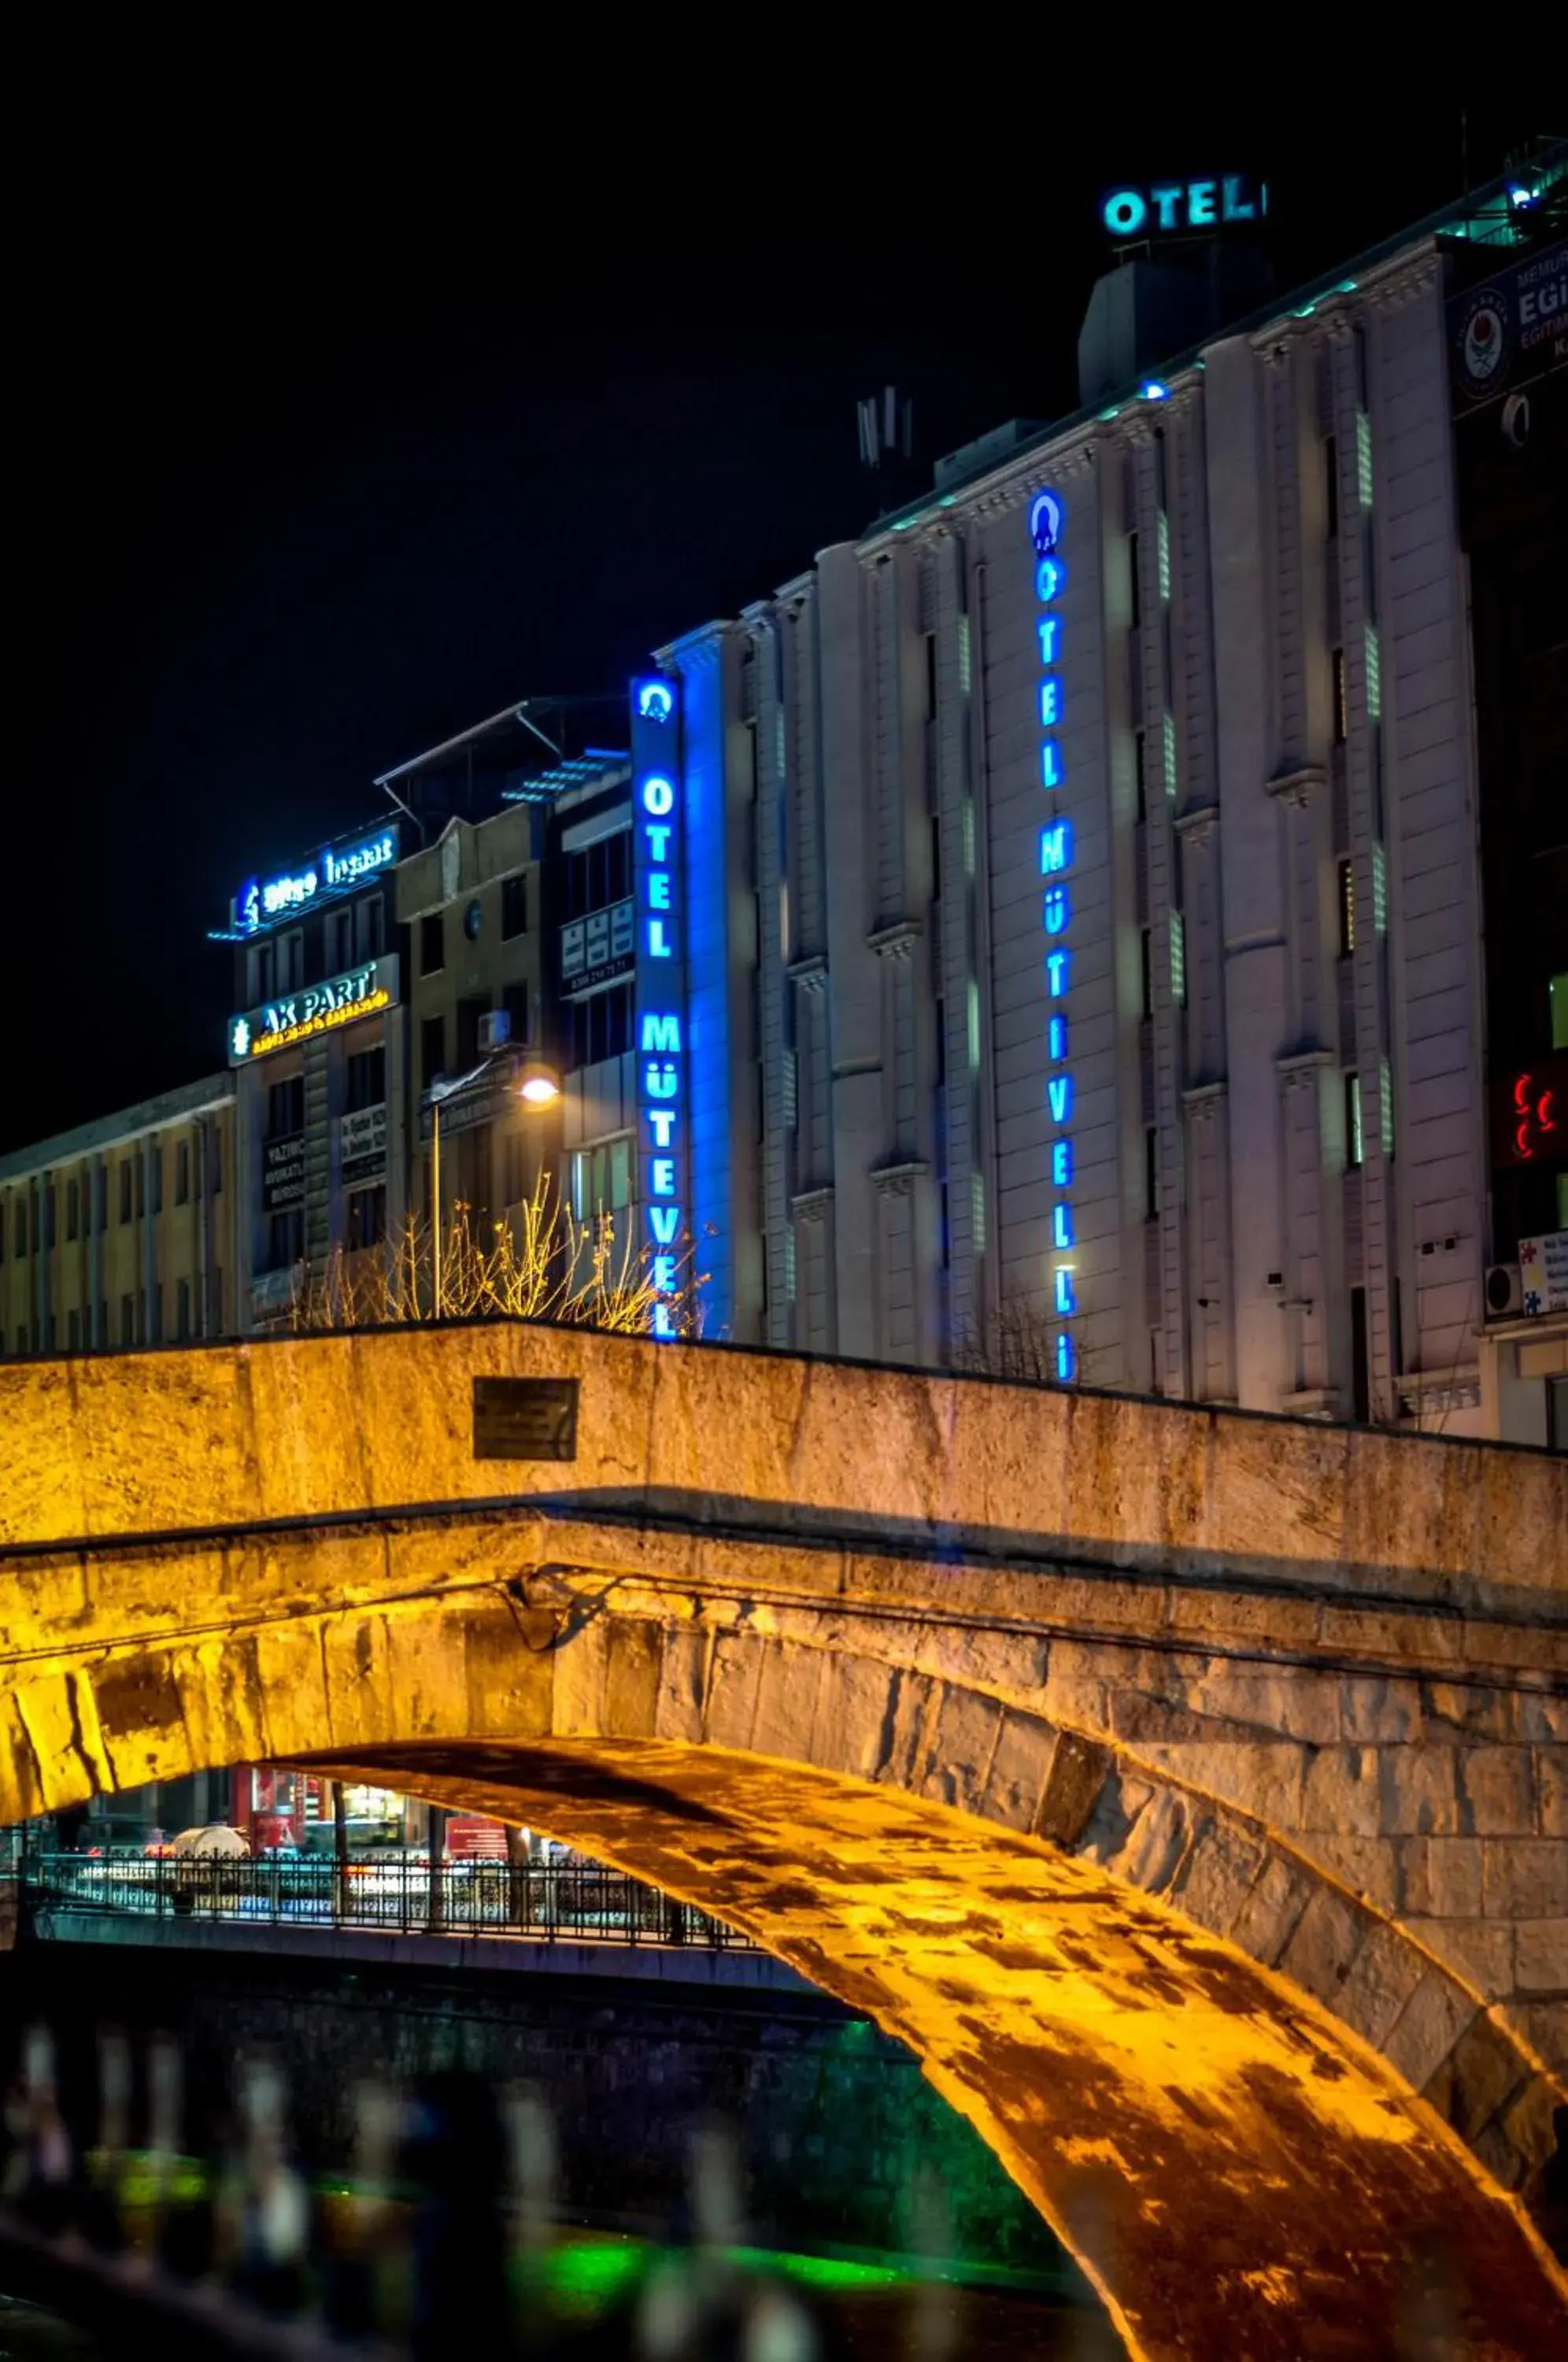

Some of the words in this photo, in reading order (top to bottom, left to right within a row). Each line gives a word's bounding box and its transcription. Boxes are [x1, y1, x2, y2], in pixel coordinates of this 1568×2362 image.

[1104, 177, 1255, 235] OTEL
[1035, 558, 1058, 789] OTEL
[642, 777, 674, 957] OTEL
